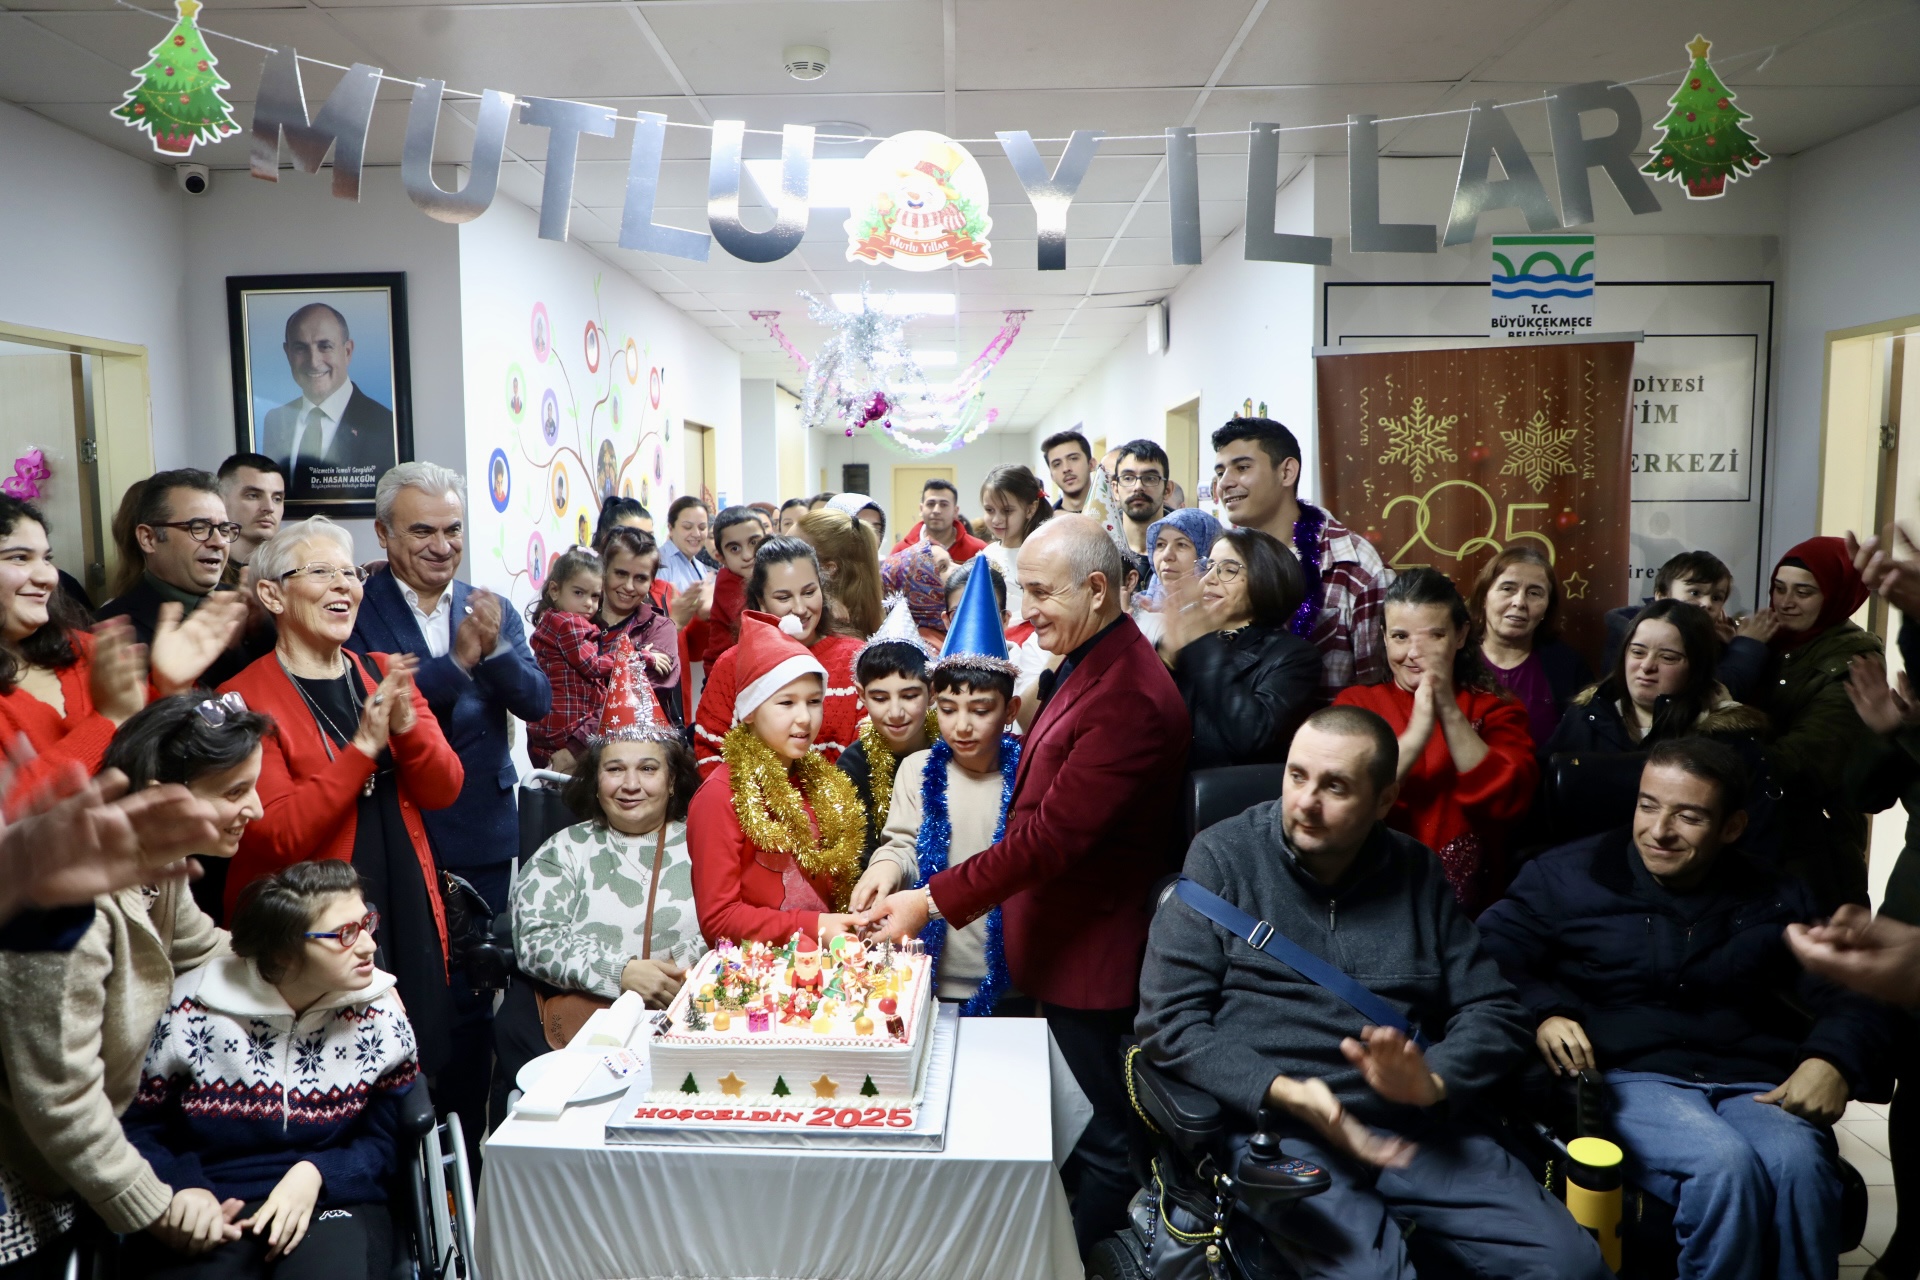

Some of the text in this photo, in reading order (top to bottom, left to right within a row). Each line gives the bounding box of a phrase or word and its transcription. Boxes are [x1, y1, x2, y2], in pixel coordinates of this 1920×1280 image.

[249, 44, 1662, 271] MUTLU YILLAR
[1532, 304, 1552, 314] T.C.
[1491, 315, 1592, 331] BÜYÜKÇEKMECE
[1633, 399, 1679, 424] İM
[311, 476, 322, 484] Dr.
[349, 474, 376, 482] AKGÜN
[634, 1106, 913, 1128] HOŞGELDİN 2025
